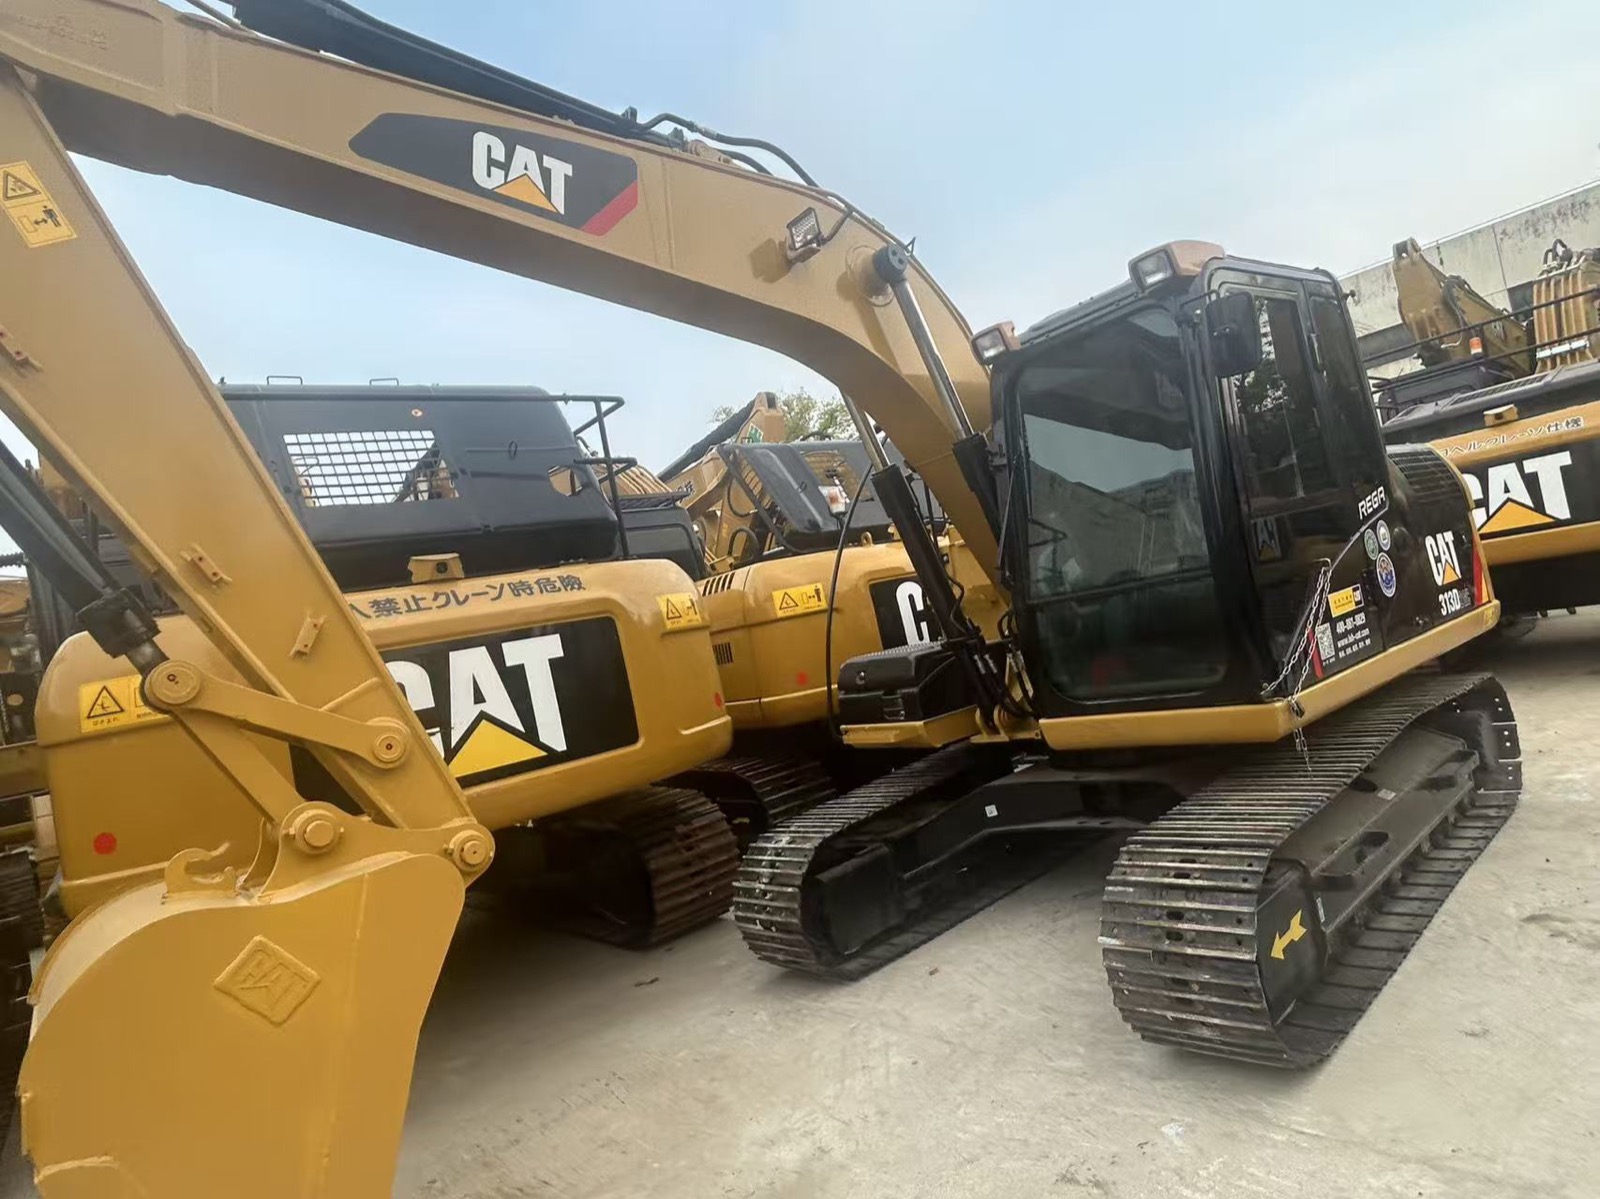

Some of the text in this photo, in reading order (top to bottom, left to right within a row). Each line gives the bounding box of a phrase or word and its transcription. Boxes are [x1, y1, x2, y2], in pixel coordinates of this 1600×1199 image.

[472, 131, 573, 215] CAT
[1425, 530, 1462, 587] CAT
[1438, 588, 1461, 616] 313D
[232, 948, 310, 1010] CAT
